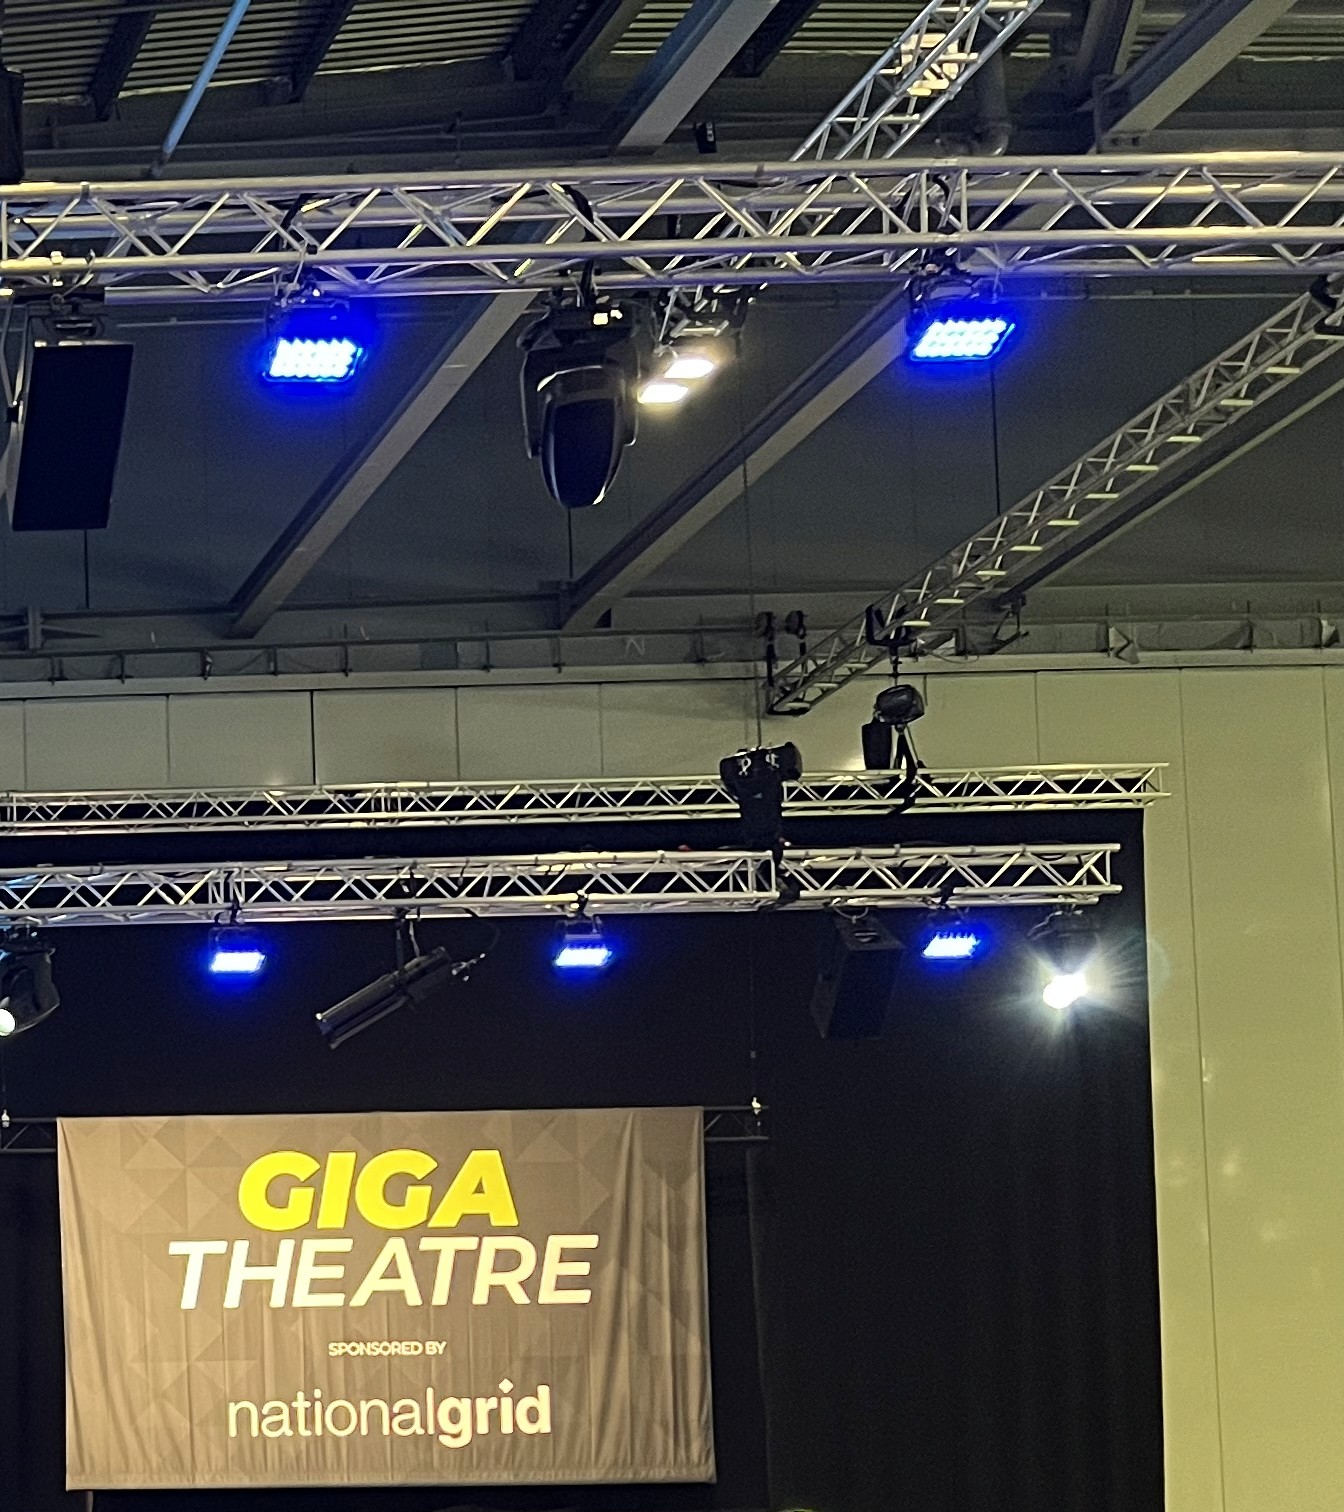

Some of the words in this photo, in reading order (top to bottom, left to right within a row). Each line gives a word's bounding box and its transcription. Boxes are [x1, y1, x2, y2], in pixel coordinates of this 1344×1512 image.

[238, 1149, 519, 1231] GIGA
[168, 1234, 600, 1310] THEATRE
[328, 1341, 424, 1356] SPONSORED
[425, 1341, 447, 1355] BY
[228, 1378, 551, 1448] nationalgrid
